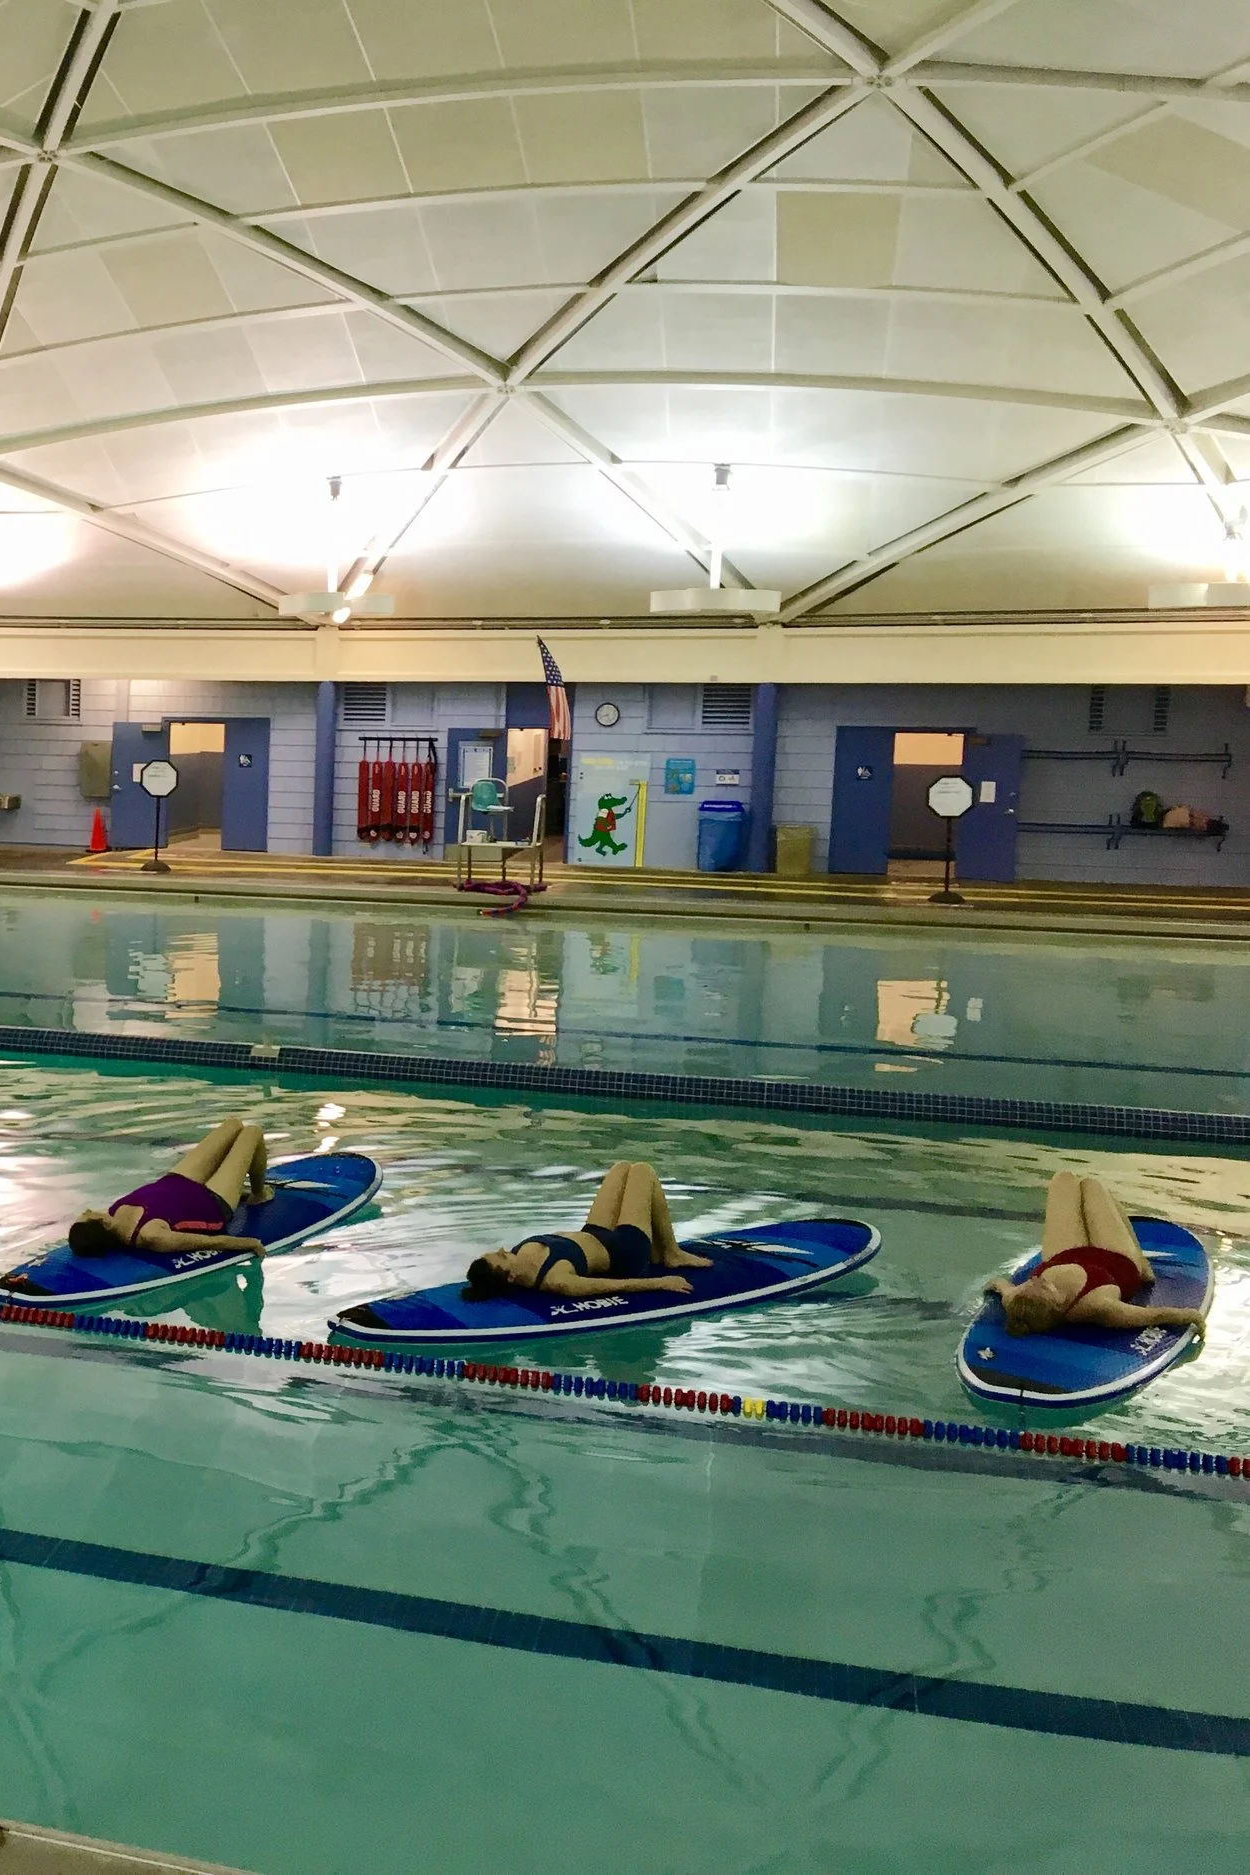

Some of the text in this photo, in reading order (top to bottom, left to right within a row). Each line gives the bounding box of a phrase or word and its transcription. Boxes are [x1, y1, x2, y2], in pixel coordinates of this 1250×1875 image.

[371, 789, 381, 812] GUARD
[397, 790, 406, 813] GUARD
[411, 790, 420, 813] GUARD
[572, 1296, 629, 1311] HOBIE
